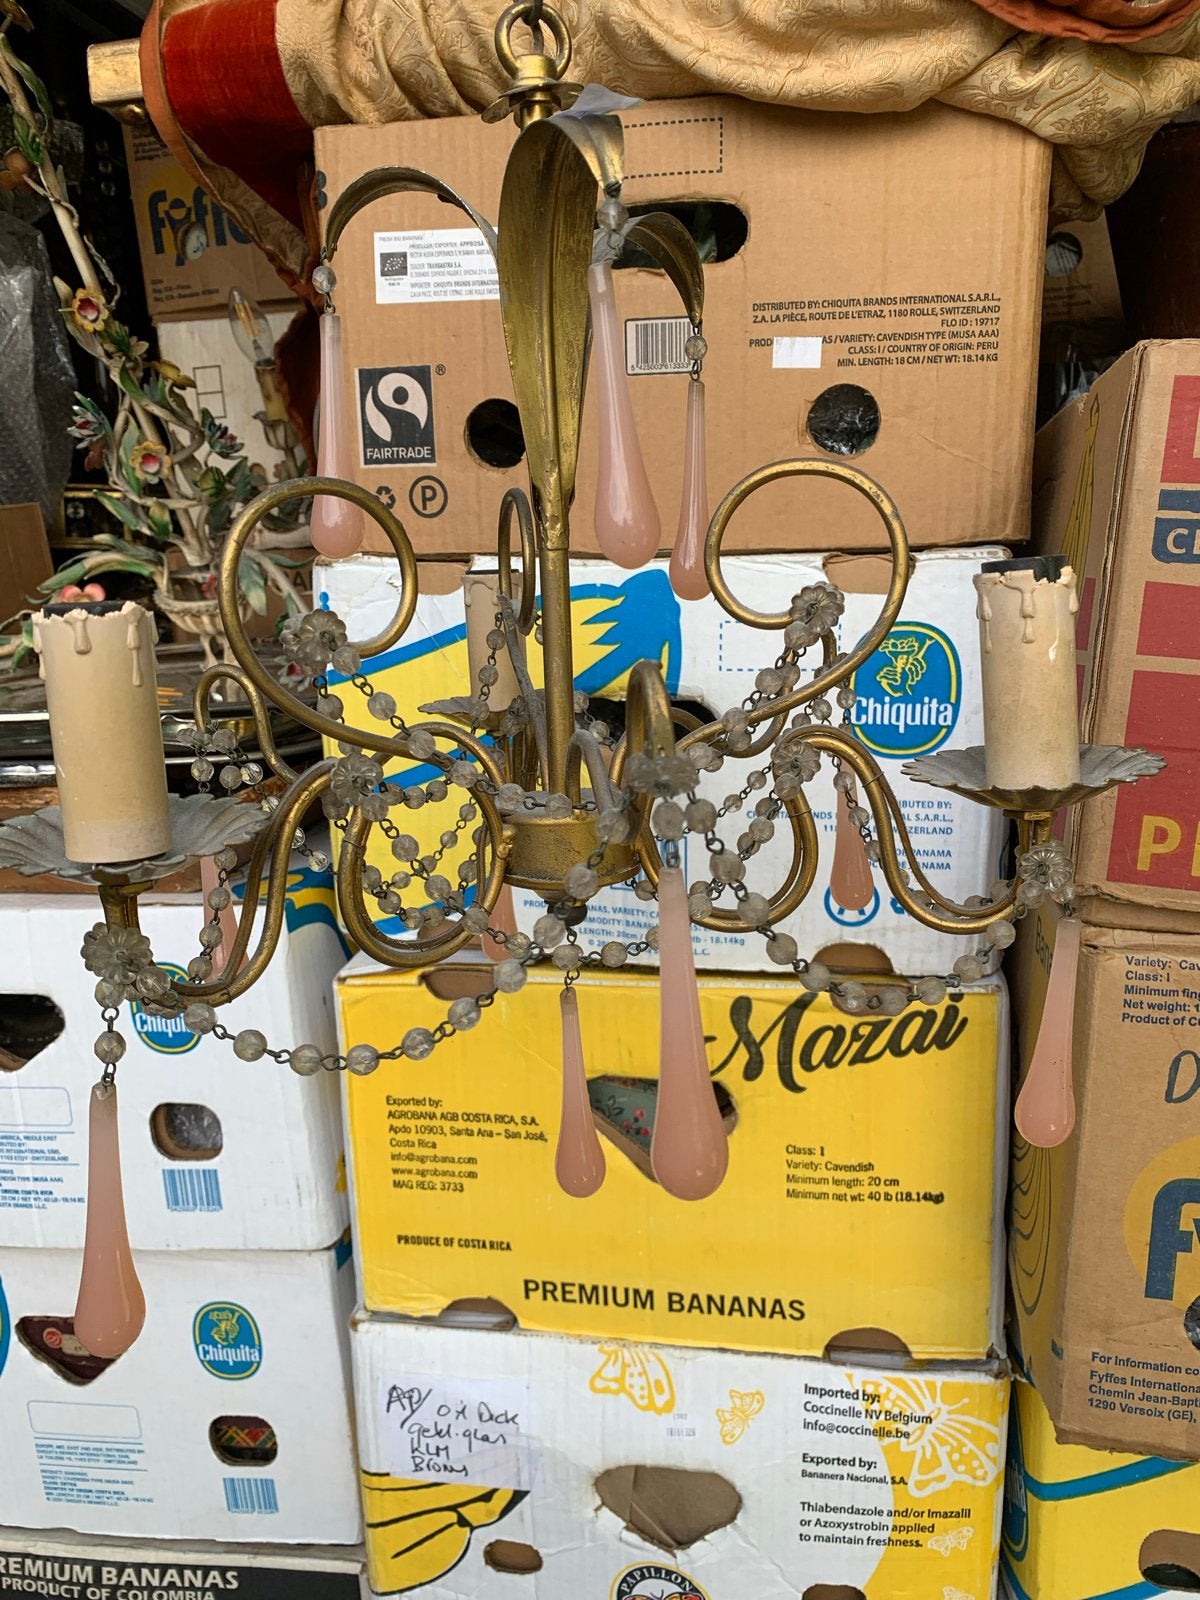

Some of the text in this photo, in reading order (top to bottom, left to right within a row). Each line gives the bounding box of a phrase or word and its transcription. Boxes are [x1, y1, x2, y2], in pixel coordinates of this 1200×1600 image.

[752, 301, 806, 312] DISTRIBUTED
[808, 300, 820, 309] BY:
[822, 298, 862, 309] CHIQUITA
[863, 297, 898, 307] BRANDS
[899, 294, 966, 305] INTERNATIONAL
[752, 316, 768, 324] Z.A.
[770, 314, 781, 322] LA
[782, 312, 808, 323] PIÈCE,
[808, 312, 837, 320] ROUTE
[838, 311, 850, 320] DE
[888, 309, 908, 318] 1180
[910, 307, 938, 317] ROLLE,
[940, 304, 1000, 316] SWITZERLAND
[941, 318, 958, 328] FLO
[958, 318, 968, 326] ID
[974, 318, 1000, 326] 19717
[838, 334, 875, 344] VARIETY:
[876, 332, 924, 342] CAVENDISH
[926, 331, 946, 340] TYPE
[948, 330, 976, 340] (MUSA
[978, 328, 1000, 338] AAA)
[848, 346, 876, 354] CLASS:
[887, 344, 928, 353] COUNTRY
[928, 343, 940, 352] OF
[942, 342, 974, 352] ORIGIN:
[976, 341, 998, 350] PERU
[837, 358, 856, 368] MIN.
[858, 357, 894, 366] LENGTH:
[895, 356, 906, 365] 18
[906, 356, 920, 364] CM
[926, 355, 944, 364] NET
[944, 354, 960, 363] WT:
[962, 354, 985, 362] 18.14
[986, 353, 998, 362] KG
[366, 446, 432, 460] FAIRTRADE
[850, 696, 953, 734] Chiquita
[936, 800, 952, 809] BY:
[579, 927, 614, 938] LENGTH:
[710, 936, 745, 946] 18.14kg
[1126, 956, 1172, 970] Variety:
[1126, 970, 1163, 982] Class:
[1124, 984, 1179, 998] Minimum
[1123, 998, 1144, 1010] Net
[1146, 1000, 1190, 1014] weight:
[134, 1012, 187, 1038] Chiqui
[1122, 1012, 1170, 1025] Product
[1173, 1016, 1186, 1026] of
[705, 992, 969, 1094] Mazai
[386, 1095, 442, 1108] Exported by:
[387, 1110, 540, 1126] AGROBANA AGB COSTA RICA, S.A.
[388, 1124, 548, 1142] Apdo 10903, Santa Ana San José,
[390, 1138, 437, 1149] Costa Rica
[786, 1144, 825, 1156] Class: 1
[390, 1152, 478, 1166] info@agrobana.com
[786, 1159, 874, 1172] Variety: Cavendish
[392, 1166, 478, 1180] www.agrobana.com
[393, 1179, 464, 1192] MAG REG: 3733
[786, 1174, 900, 1189] Minimum length: 20 cm
[786, 1188, 944, 1204] Minimum net wt: 40 lb (18.14kg)
[396, 1234, 512, 1252] PRODUCE OF COSTA RICA
[523, 1278, 807, 1322] PREMIUM BANANAS
[198, 1344, 260, 1366] Chiquita
[1092, 1352, 1112, 1364] For
[1114, 1356, 1182, 1374] information
[1090, 1370, 1127, 1385] Fyffes
[804, 1384, 881, 1405] Imported by:
[1088, 1384, 1200, 1408] Chemin Jean-Bapt
[804, 1400, 933, 1425] Coccinelle NV Belgium
[1088, 1398, 1196, 1424] 1290 Versoix (GE),
[803, 1418, 910, 1440] info@coccinelle.be
[802, 1452, 877, 1470] Exported by:
[801, 1469, 908, 1486] Bananera Nacional, S.A.
[800, 1501, 972, 1519] Thiabendazole and/or Imazalil
[814, 1518, 890, 1532] Azoxystrobin
[891, 1523, 935, 1534] applied
[799, 1532, 923, 1548] to maintain freshness.
[101, 1566, 239, 1590] BANANAS
[620, 1567, 694, 1592] PAPILLON
[2, 1576, 81, 1598] PRODUCT
[86, 1586, 111, 1600] OF
